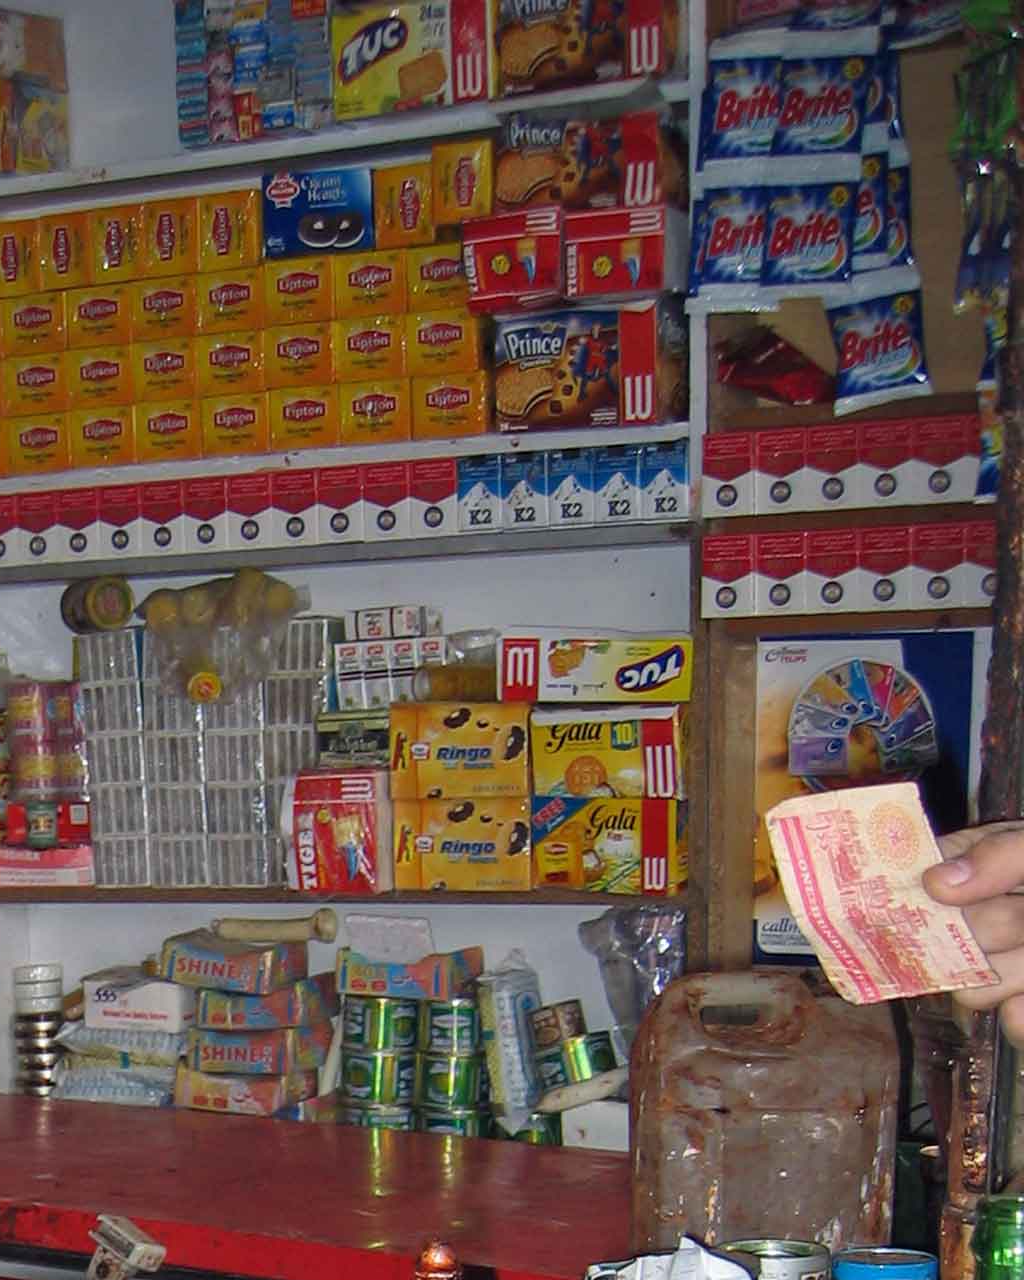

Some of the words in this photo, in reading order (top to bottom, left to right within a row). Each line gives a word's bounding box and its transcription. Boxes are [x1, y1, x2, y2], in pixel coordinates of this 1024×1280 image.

[342, 21, 401, 76] TUC
[630, 26, 660, 74] LU
[455, 54, 484, 97] LU
[780, 86, 853, 129] Brite
[511, 119, 562, 147] Prince
[624, 161, 656, 207] LU
[707, 215, 763, 258] Brit
[767, 214, 841, 260] Brite
[279, 276, 319, 292] Lipton
[80, 303, 118, 319] Lipton
[145, 295, 182, 312] Lipton
[16, 310, 51, 328] Lipton
[350, 334, 390, 352] Lipton
[419, 327, 462, 345] Lipton
[841, 322, 913, 369] Brite
[279, 342, 319, 360] Lipton
[508, 333, 562, 360] Prince
[211, 349, 250, 366] Lipton
[18, 370, 55, 387] Lipton
[81, 363, 119, 380] Lipton
[427, 390, 469, 408] Lipton
[625, 375, 653, 421] LU
[214, 409, 254, 428] Lipton
[285, 402, 325, 422] Lipton
[514, 505, 536, 523] K2
[561, 502, 583, 519] K2
[608, 500, 631, 517] K2
[655, 496, 678, 513] K2
[469, 508, 492, 526] K2
[507, 647, 534, 687] LU
[622, 646, 682, 690] TUC
[436, 746, 492, 761] Ringo
[645, 744, 674, 798] LU
[585, 803, 637, 841] Gala
[440, 841, 496, 856] Ringo
[643, 856, 666, 890] LU
[175, 957, 235, 978] SHINE
[200, 1043, 257, 1062] SHINE
